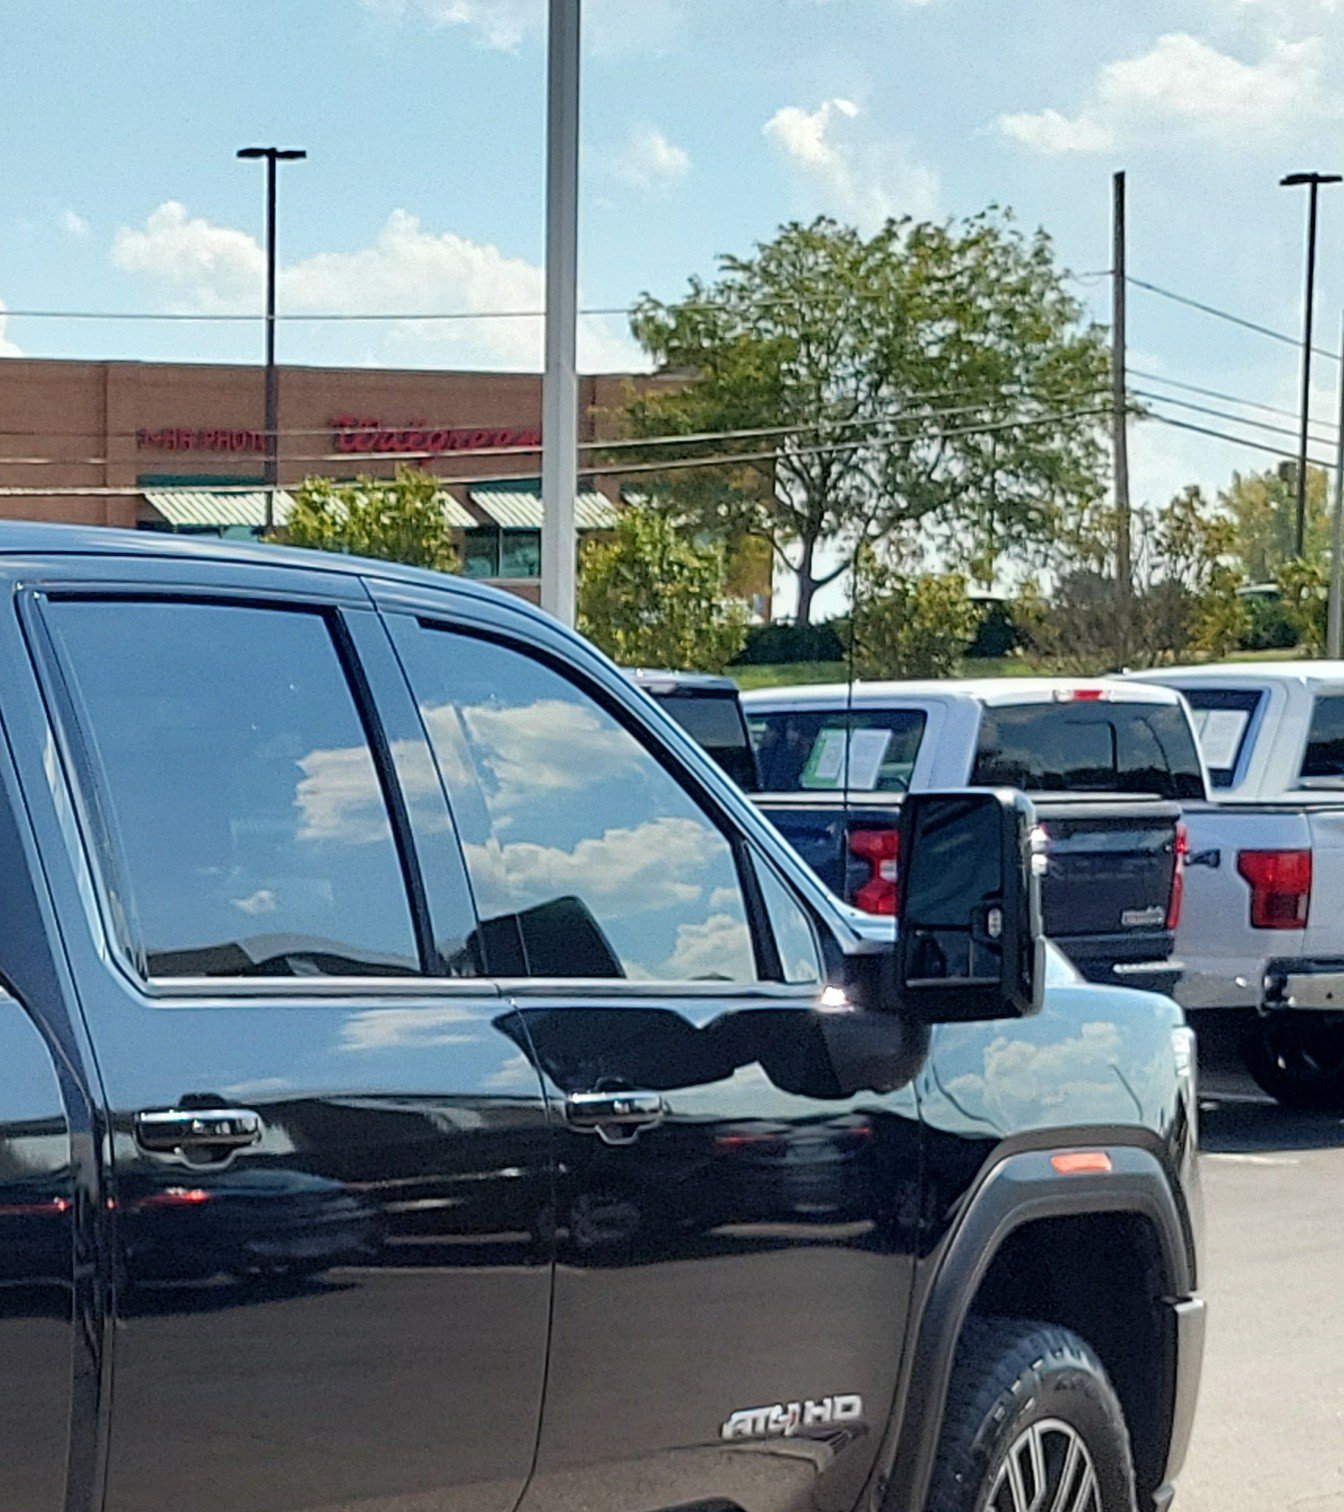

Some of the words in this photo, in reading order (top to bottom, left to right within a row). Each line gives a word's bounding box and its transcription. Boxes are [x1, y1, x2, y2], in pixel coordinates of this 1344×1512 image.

[328, 416, 543, 466] Walgreen
[721, 1403, 800, 1440] AT4
[803, 1394, 863, 1424] HD
